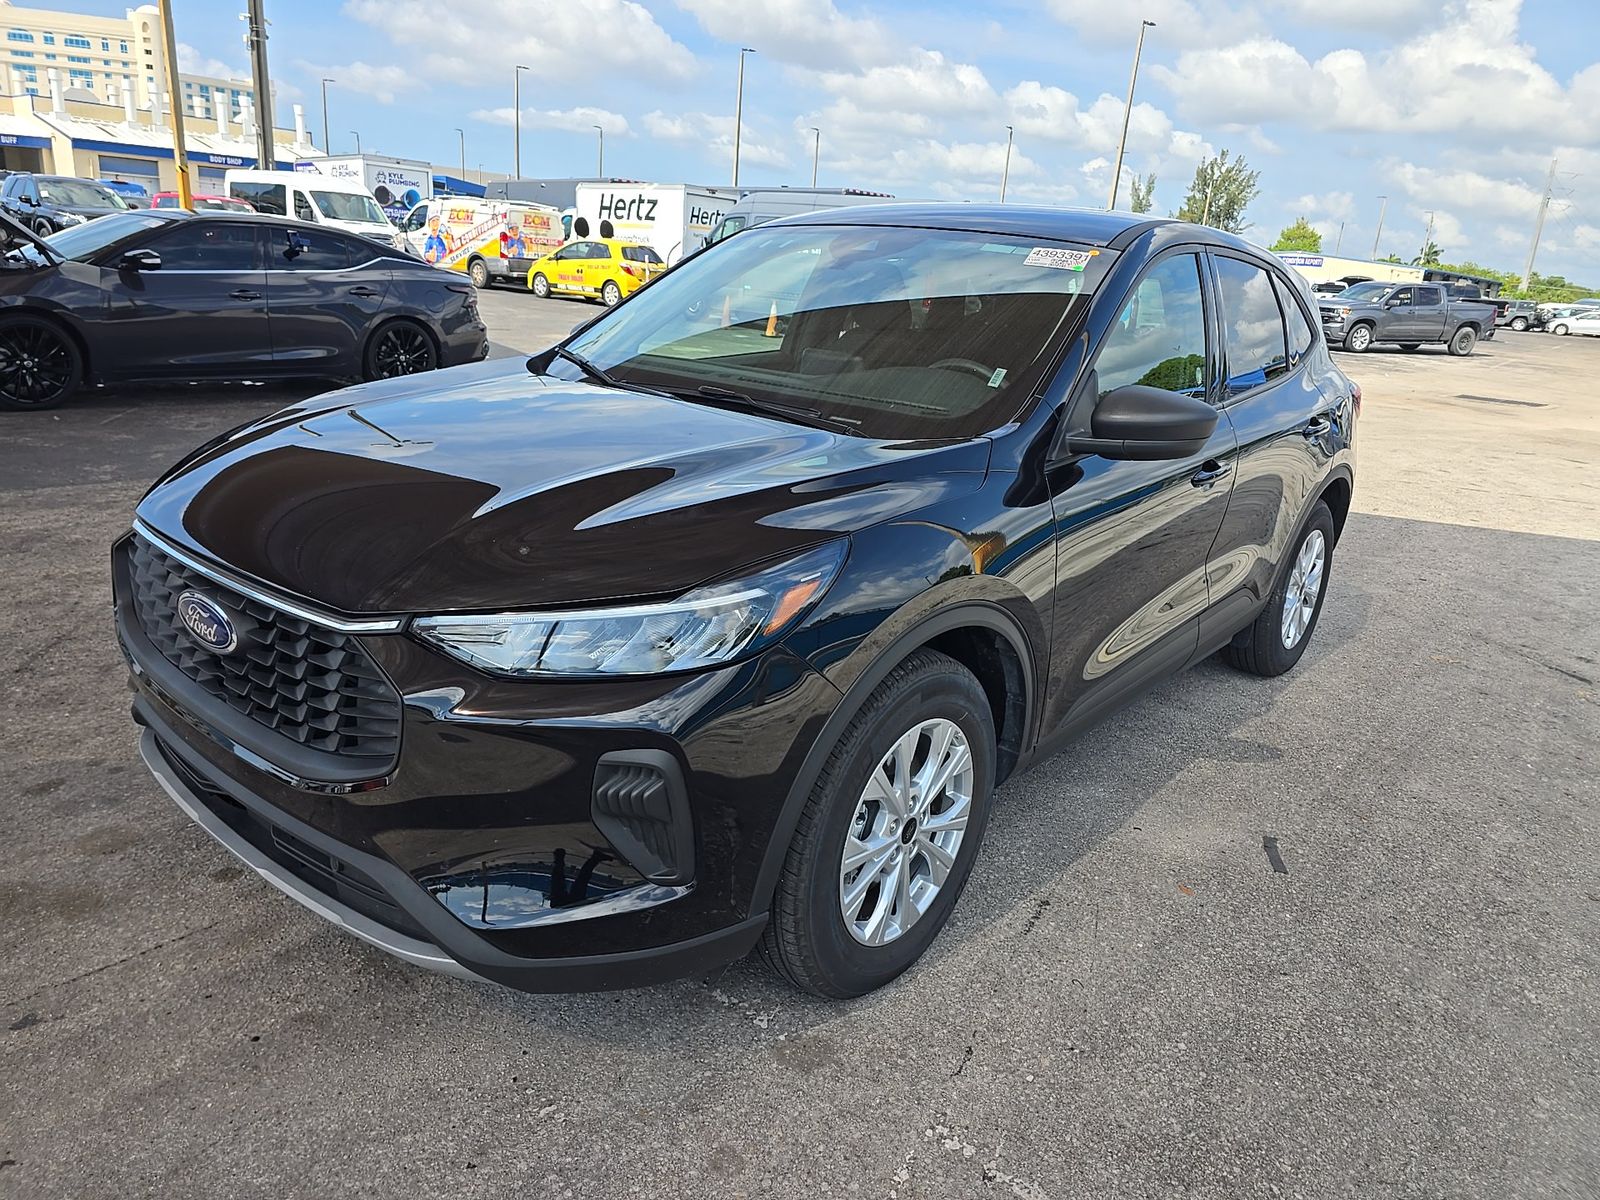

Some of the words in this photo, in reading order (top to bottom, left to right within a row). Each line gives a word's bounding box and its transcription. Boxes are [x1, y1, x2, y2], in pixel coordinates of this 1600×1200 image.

[209, 155, 226, 164] BODY
[226, 157, 243, 166] SHOP
[388, 172, 404, 180] KYLE
[388, 179, 421, 189] PLUMBING
[448, 207, 476, 221] ECM
[598, 193, 658, 222] Hertz
[523, 214, 551, 227] ECM
[531, 237, 560, 247] COOLING
[1032, 249, 1090, 262] 4393391
[186, 603, 218, 642] Ford
